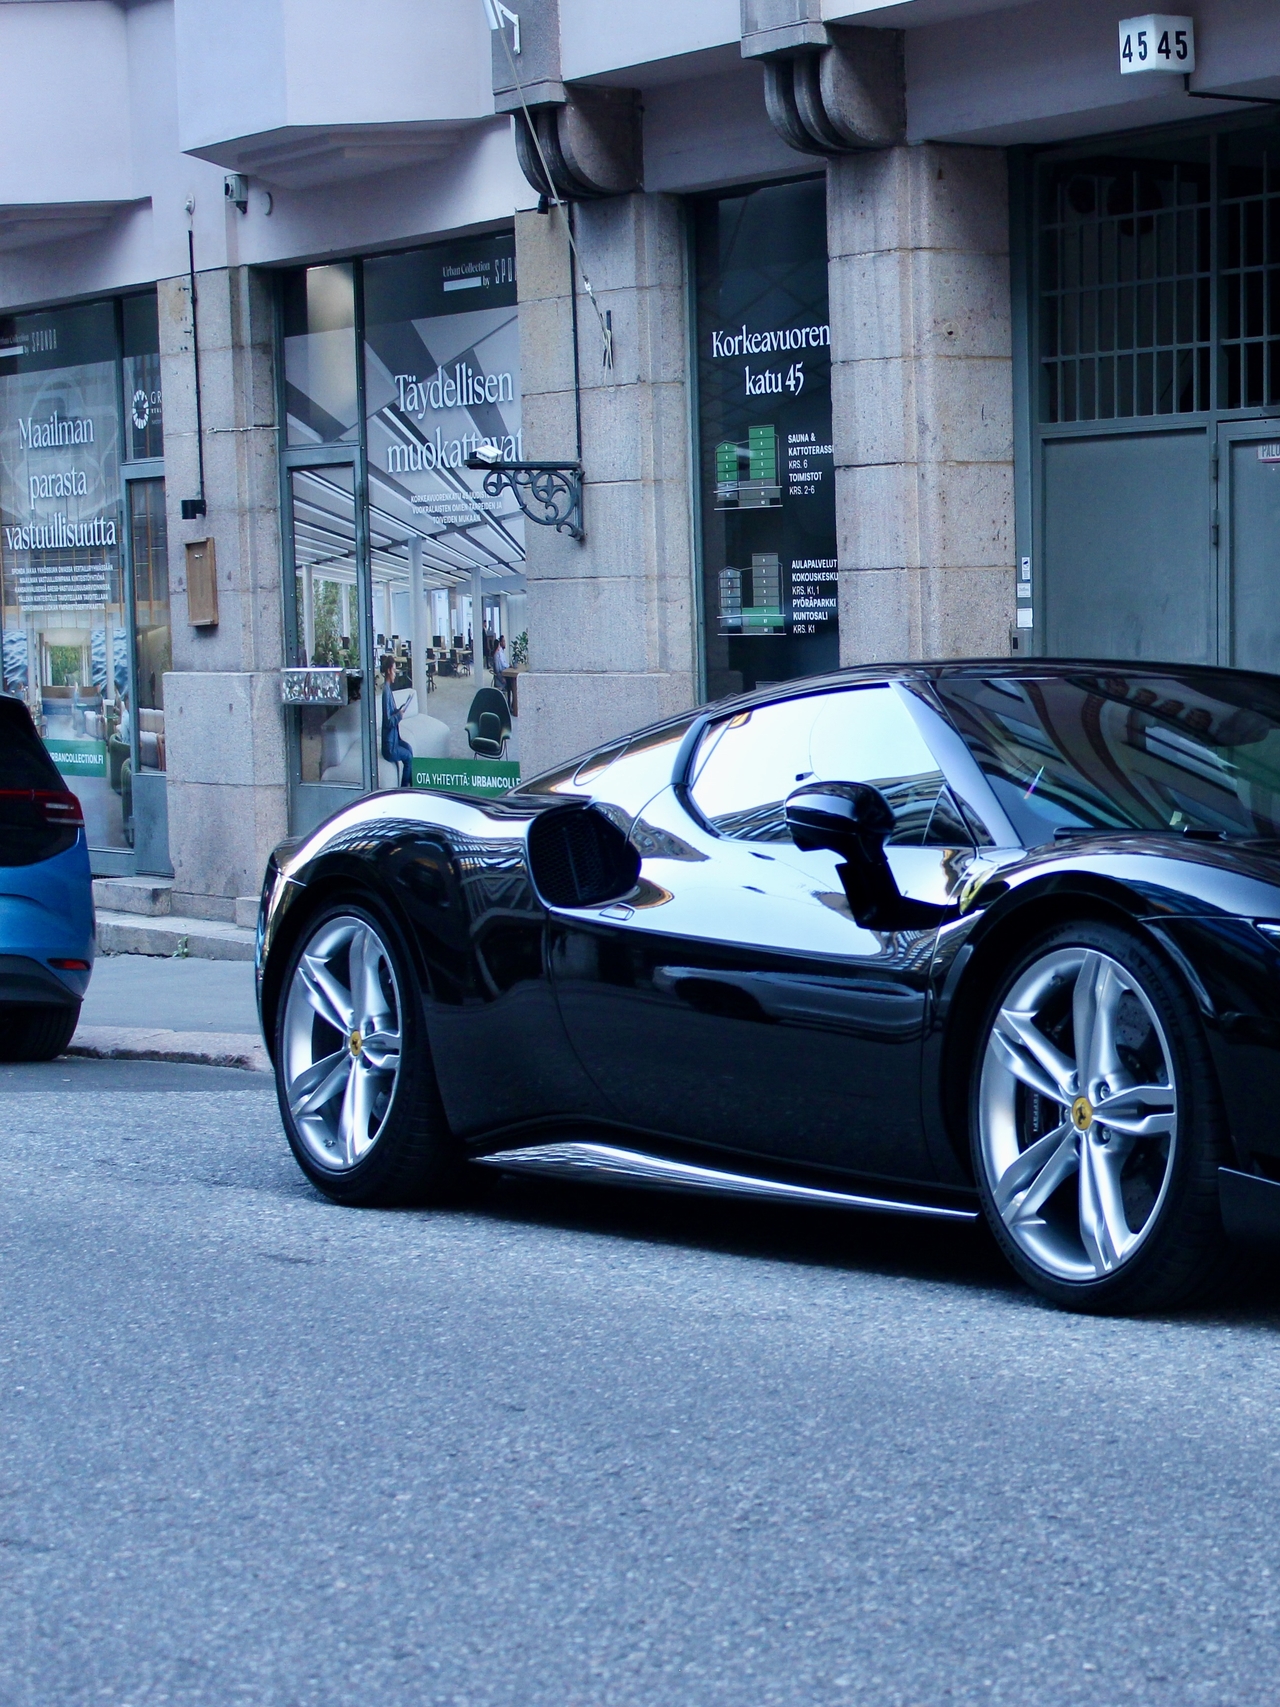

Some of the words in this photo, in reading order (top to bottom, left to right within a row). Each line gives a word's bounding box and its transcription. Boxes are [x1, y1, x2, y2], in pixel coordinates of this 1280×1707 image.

[1122, 31, 1148, 63] 45
[1157, 31, 1188, 60] 45
[442, 265, 460, 278] Urban
[460, 261, 491, 275] Collection
[482, 275, 490, 289] by
[711, 324, 831, 358] Korkeavuoren
[744, 366, 783, 396] katu
[785, 361, 805, 396] 45
[394, 361, 514, 420] Täydellisen
[18, 410, 94, 450] Maailman
[787, 433, 808, 444] SAUNA
[810, 432, 816, 442] &
[788, 459, 802, 470] KRS.
[803, 459, 808, 469] 6
[788, 471, 823, 483] TOIMISTOT
[29, 466, 88, 510] parasta
[789, 487, 802, 496] KRS.
[804, 485, 815, 495] 2-6
[5, 512, 117, 550] vastuullisuutta
[791, 559, 838, 570] AULAPALVELUT
[791, 586, 805, 596] KRS.
[792, 597, 837, 608] PYÖRÄPARKKI
[792, 611, 828, 621] KUNTOSALI
[792, 625, 806, 634] KRS.
[808, 624, 815, 633] K1
[416, 772, 431, 785] OTA
[431, 772, 470, 787] YHTEYTTÄ:
